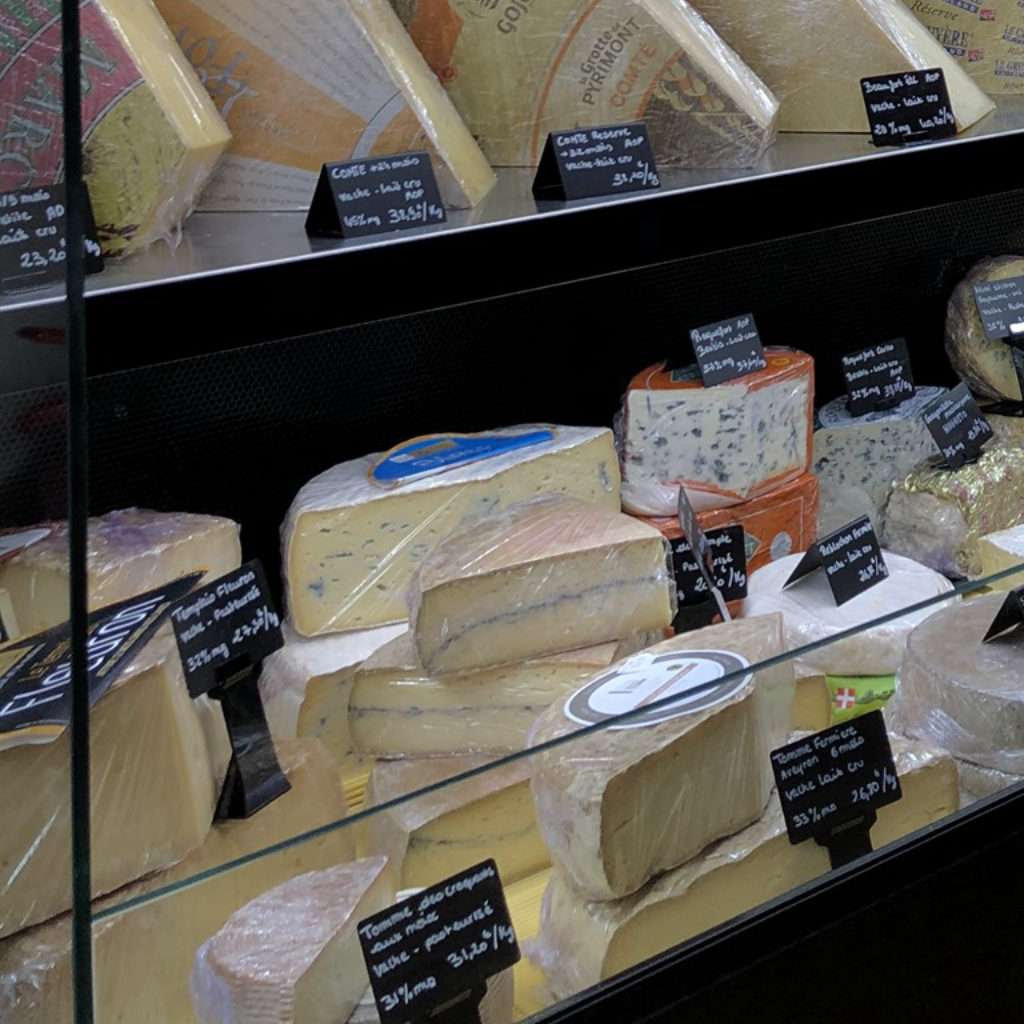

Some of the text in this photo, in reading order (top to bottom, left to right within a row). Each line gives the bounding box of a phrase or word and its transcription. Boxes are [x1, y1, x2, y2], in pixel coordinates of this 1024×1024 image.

[912, 0, 960, 23] Réserve
[581, 30, 613, 74] Grotte
[582, 16, 642, 106] PYRIMONT
[925, 72, 941, 83] AOP
[870, 101, 896, 114] vache
[624, 136, 645, 149] AOP
[46, 204, 65, 220] AO
[772, 743, 813, 766] Tomme
[780, 754, 820, 783] Aveyron
[784, 759, 866, 804] vache lait cru
[361, 906, 413, 942] Tomme
[372, 948, 411, 979] vache
